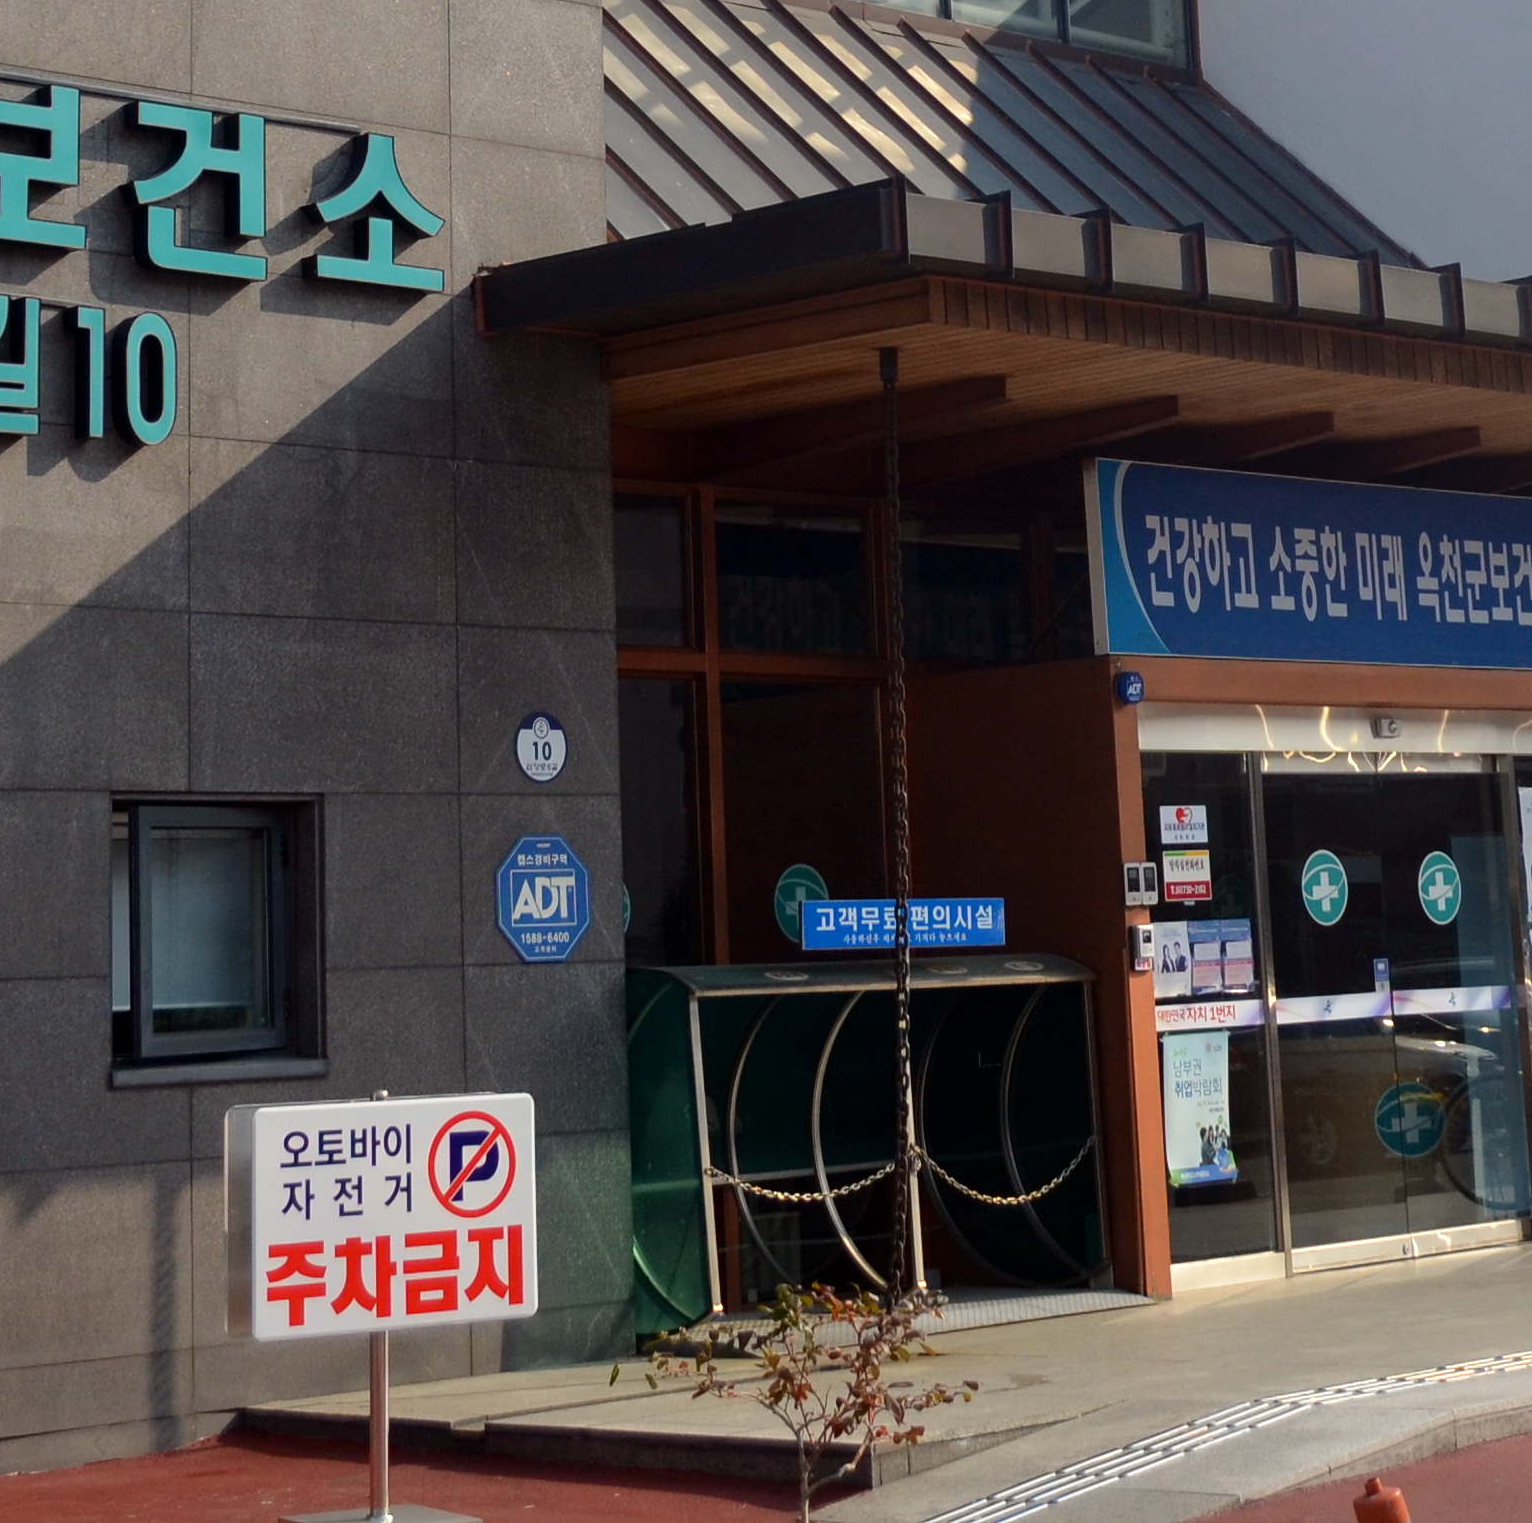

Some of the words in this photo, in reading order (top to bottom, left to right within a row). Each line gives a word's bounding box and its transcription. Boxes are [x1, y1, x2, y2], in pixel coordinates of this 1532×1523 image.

[74, 304, 179, 447] 10
[1145, 514, 1259, 612] 건강하고
[1269, 525, 1348, 622] 소중한
[1355, 532, 1408, 621] 미래
[532, 741, 552, 761] 10
[517, 854, 568, 866] 캡스경비구역
[513, 876, 575, 920] ADT
[816, 906, 897, 932] 고객무료
[910, 905, 993, 931] 편의시설
[521, 931, 570, 944] 1588-6400
[1157, 1009, 1187, 1023] 대한민국
[1187, 1005, 1207, 1023] 자치
[1209, 1004, 1236, 1023] 1번지
[1173, 1058, 1202, 1078] 남부권
[1174, 1077, 1222, 1099] 취업박람회
[279, 1123, 413, 1169] 오토바이
[281, 1172, 413, 1221] 자전거
[265, 1224, 524, 1327] 주차금지
